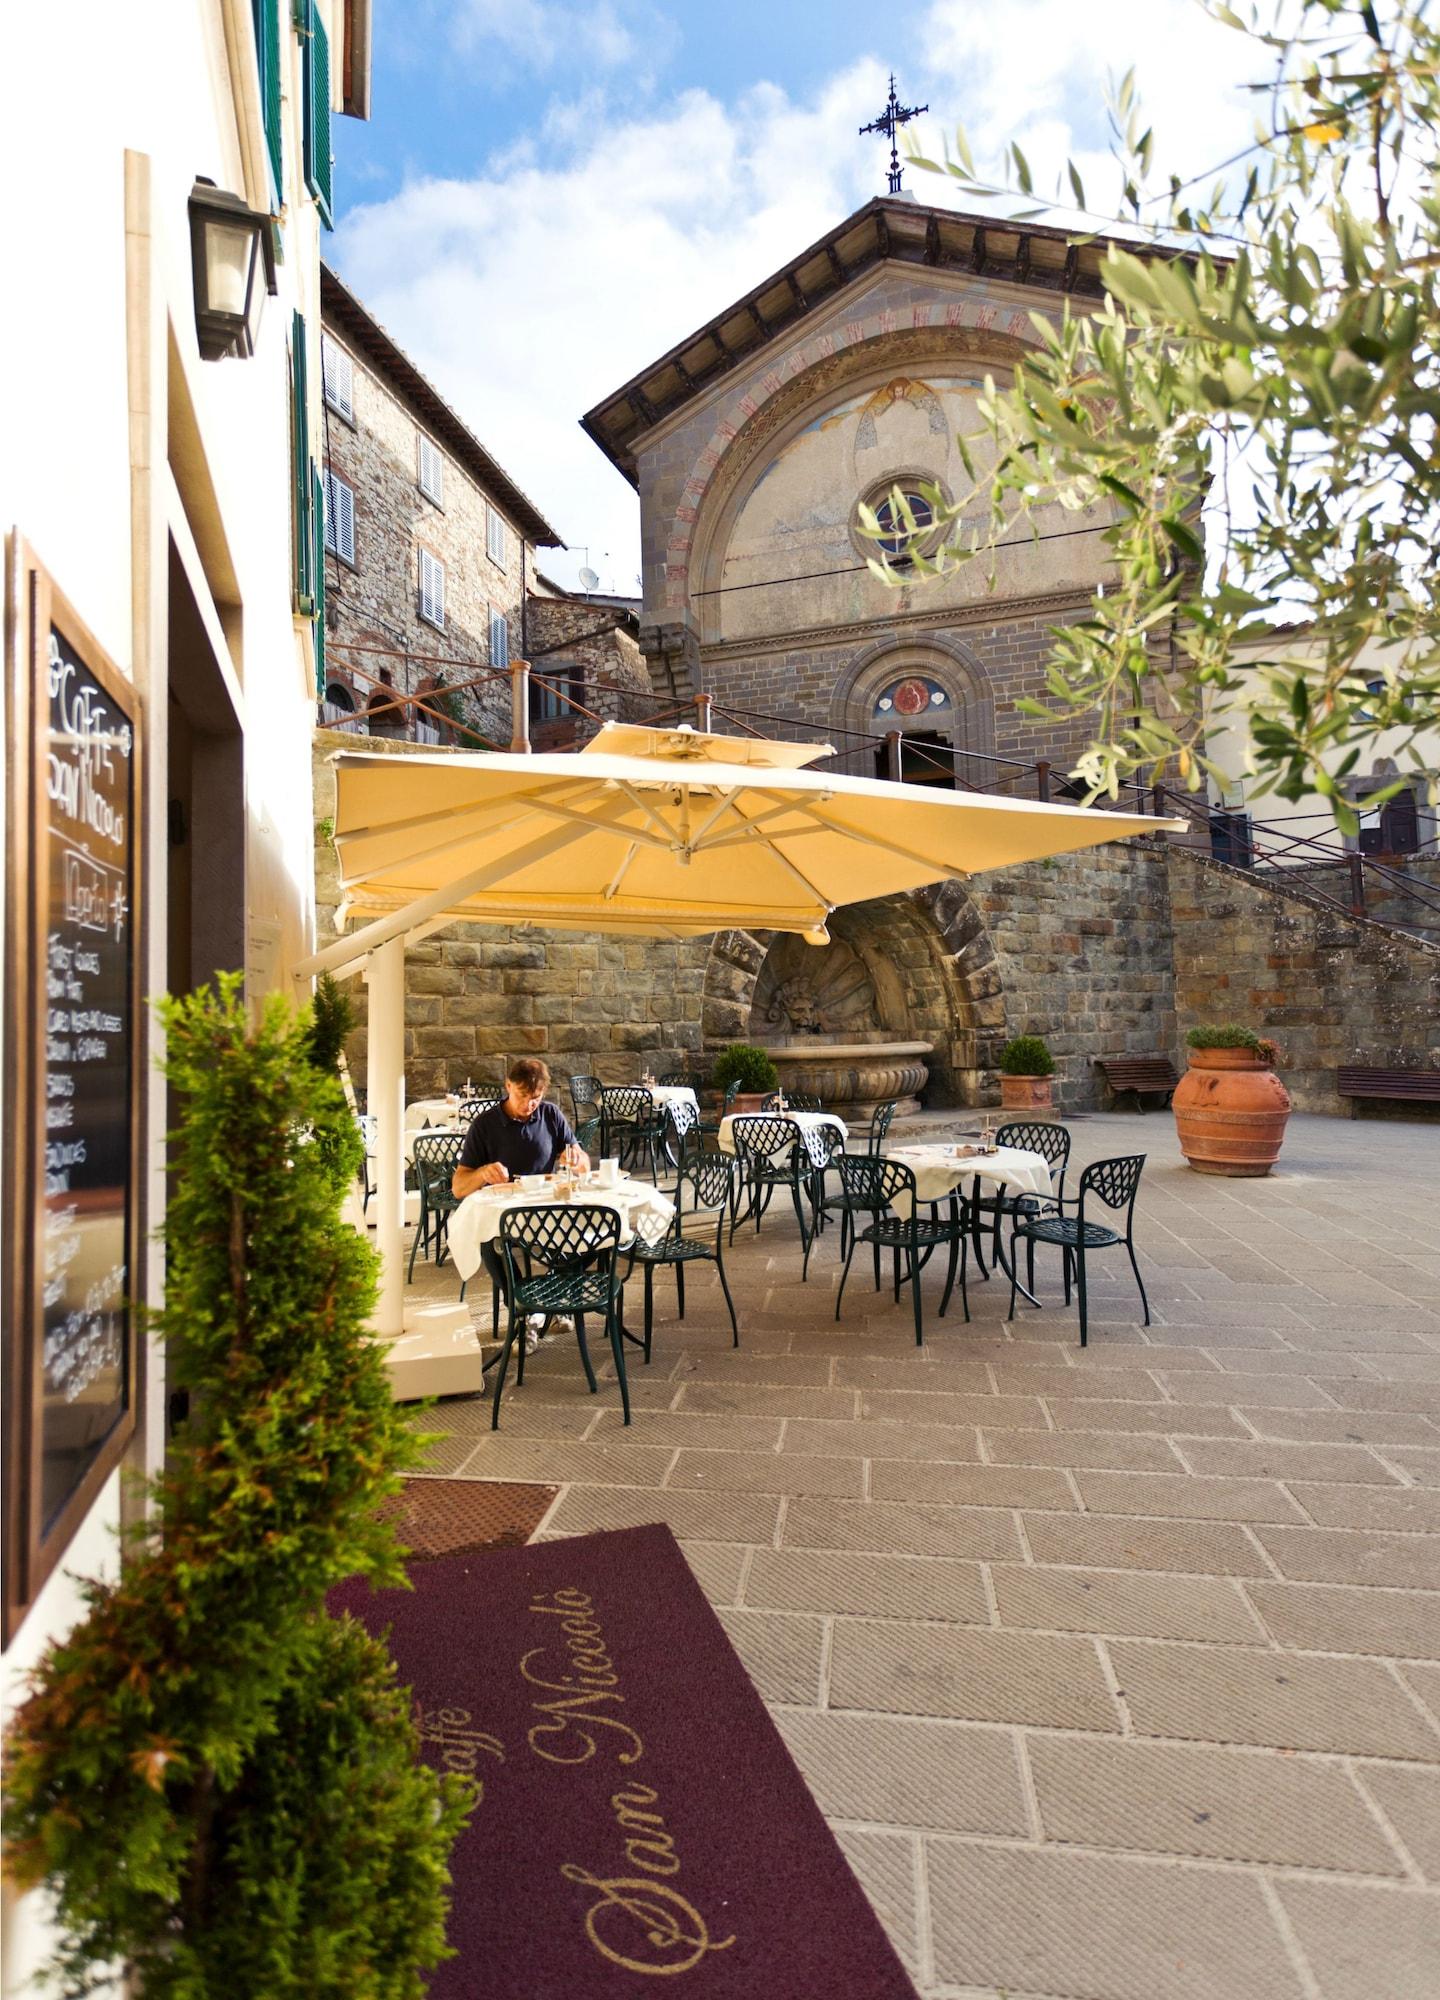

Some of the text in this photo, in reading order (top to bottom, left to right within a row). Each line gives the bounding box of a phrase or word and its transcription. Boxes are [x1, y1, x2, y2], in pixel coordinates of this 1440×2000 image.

[415, 1706, 505, 1813] affè
[520, 1586, 737, 1975] San Niccolò
